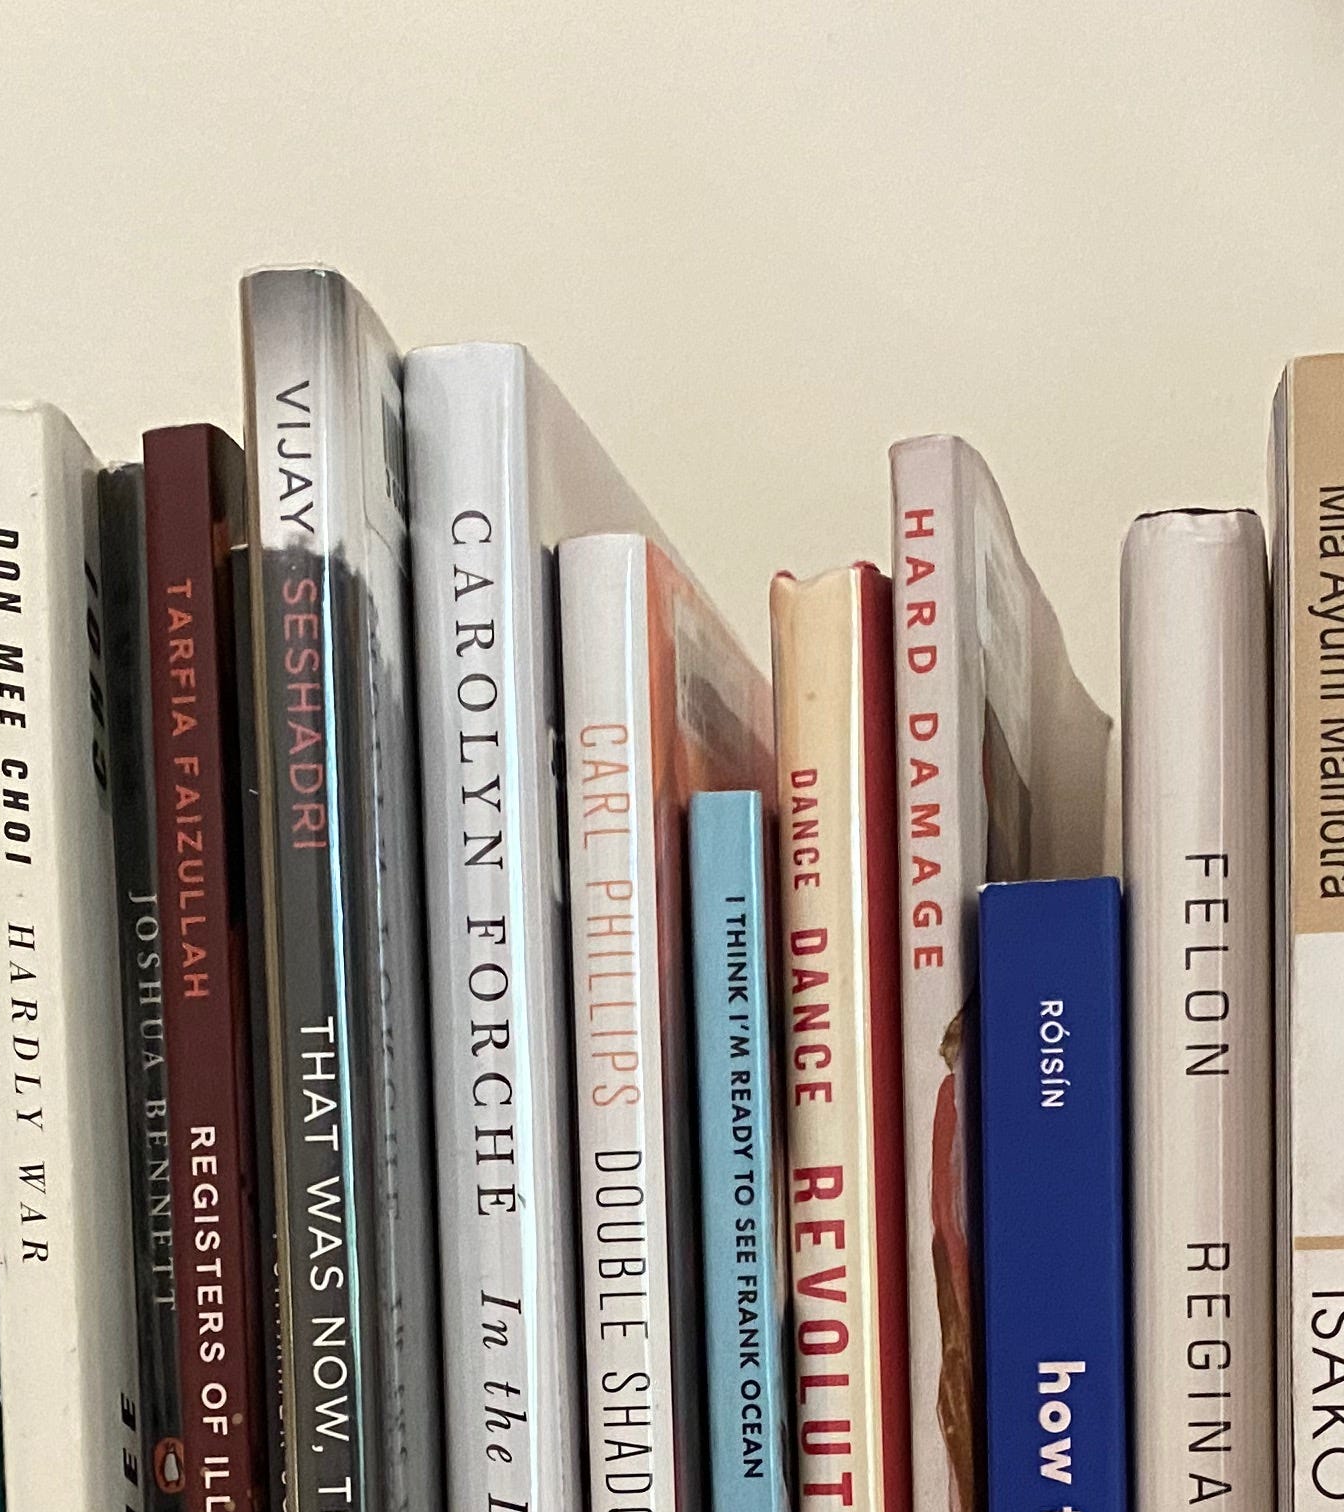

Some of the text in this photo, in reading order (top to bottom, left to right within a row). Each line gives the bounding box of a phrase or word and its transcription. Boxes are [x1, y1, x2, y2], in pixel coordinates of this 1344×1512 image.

[275, 379, 328, 850] VIJAY SESHADRI
[0, 757, 33, 866] CHOI
[579, 722, 633, 850] CARL
[903, 507, 945, 971] HARD DAMAGE
[789, 767, 821, 889] DANCE
[586, 878, 642, 1107] PHILLIPS
[789, 926, 833, 1108] DANCE
[1183, 852, 1231, 1078] FELON
[6, 923, 49, 1265] HARDLY WAR
[300, 1015, 340, 1152] THAT
[306, 1175, 345, 1292] WAS
[593, 1149, 650, 1342] DOUBLE
[310, 1316, 350, 1454] NOW,
[1037, 1360, 1087, 1486] how
